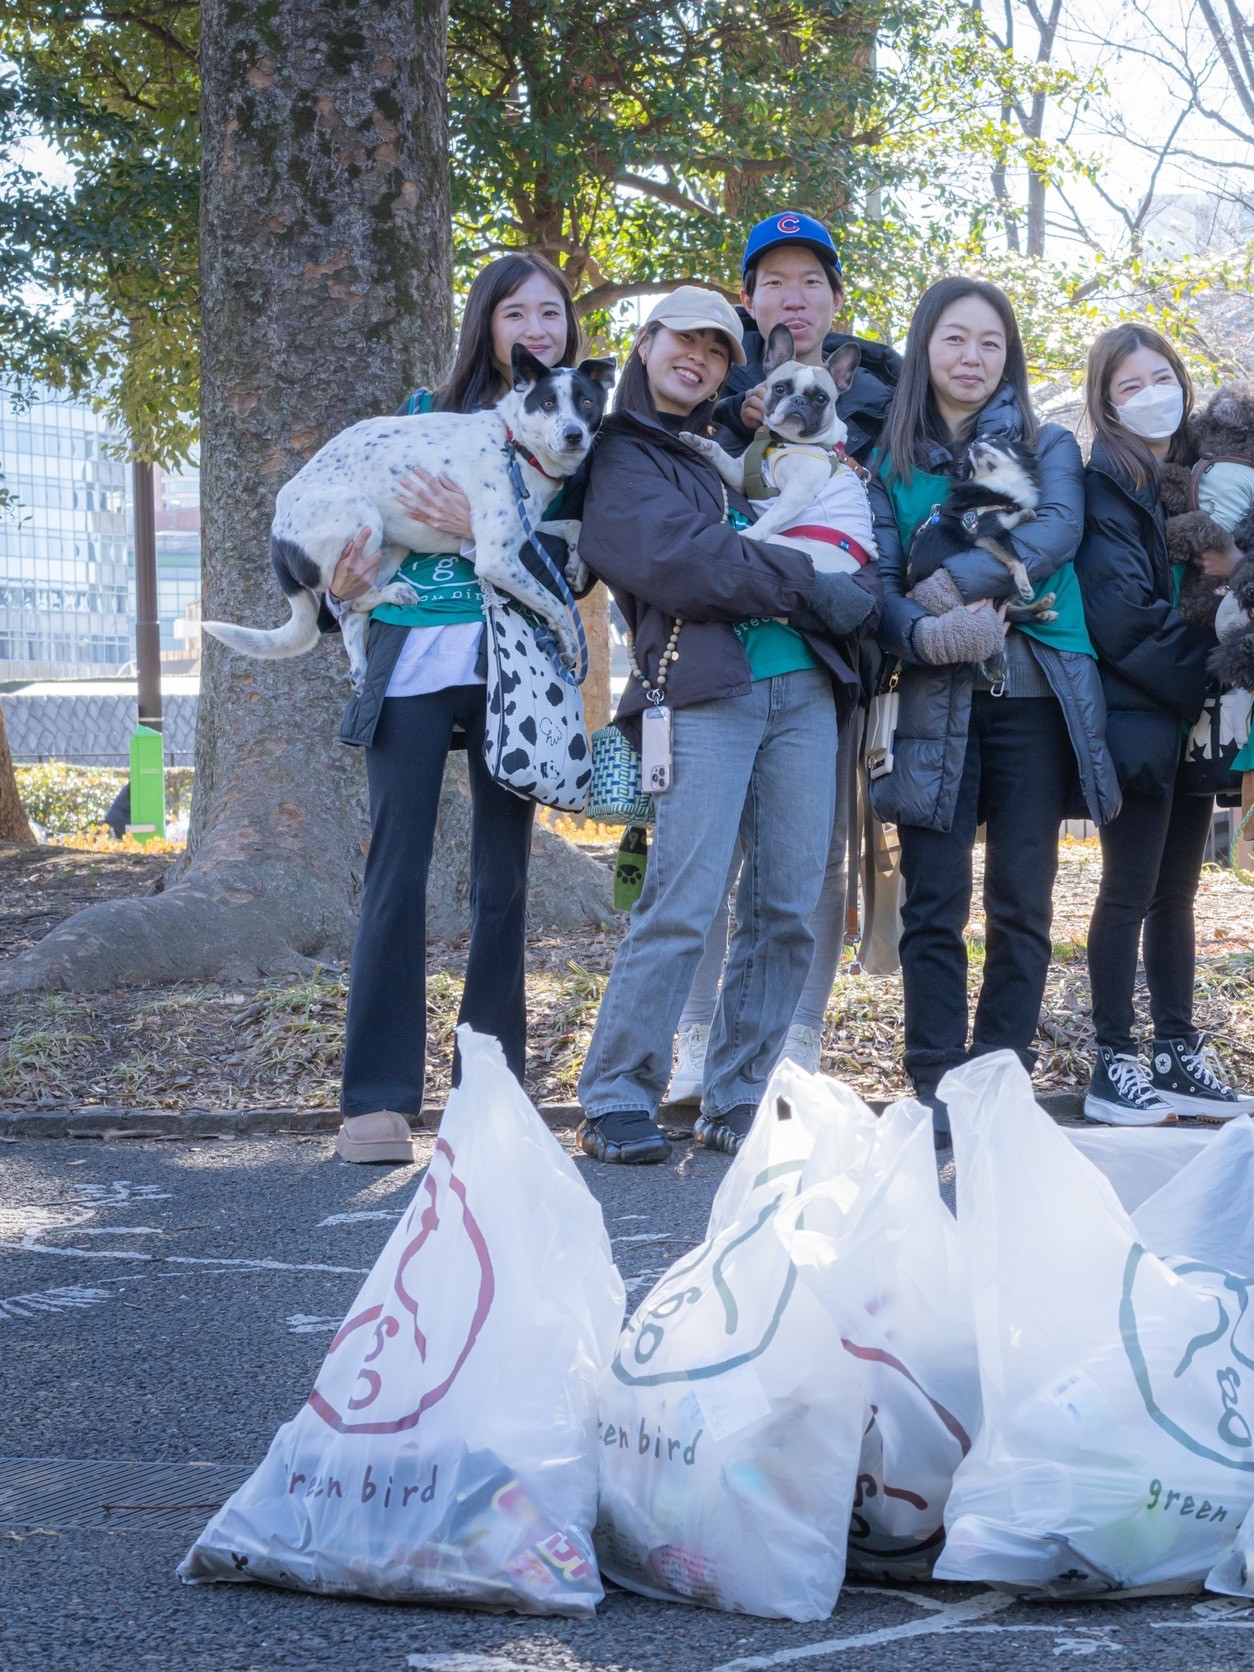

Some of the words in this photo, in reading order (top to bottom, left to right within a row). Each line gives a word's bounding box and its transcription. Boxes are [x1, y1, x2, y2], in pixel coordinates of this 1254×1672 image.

[777, 215, 800, 234] C
[639, 1417, 703, 1466] bird
[360, 1464, 438, 1508] bird
[1147, 1478, 1228, 1522] green
